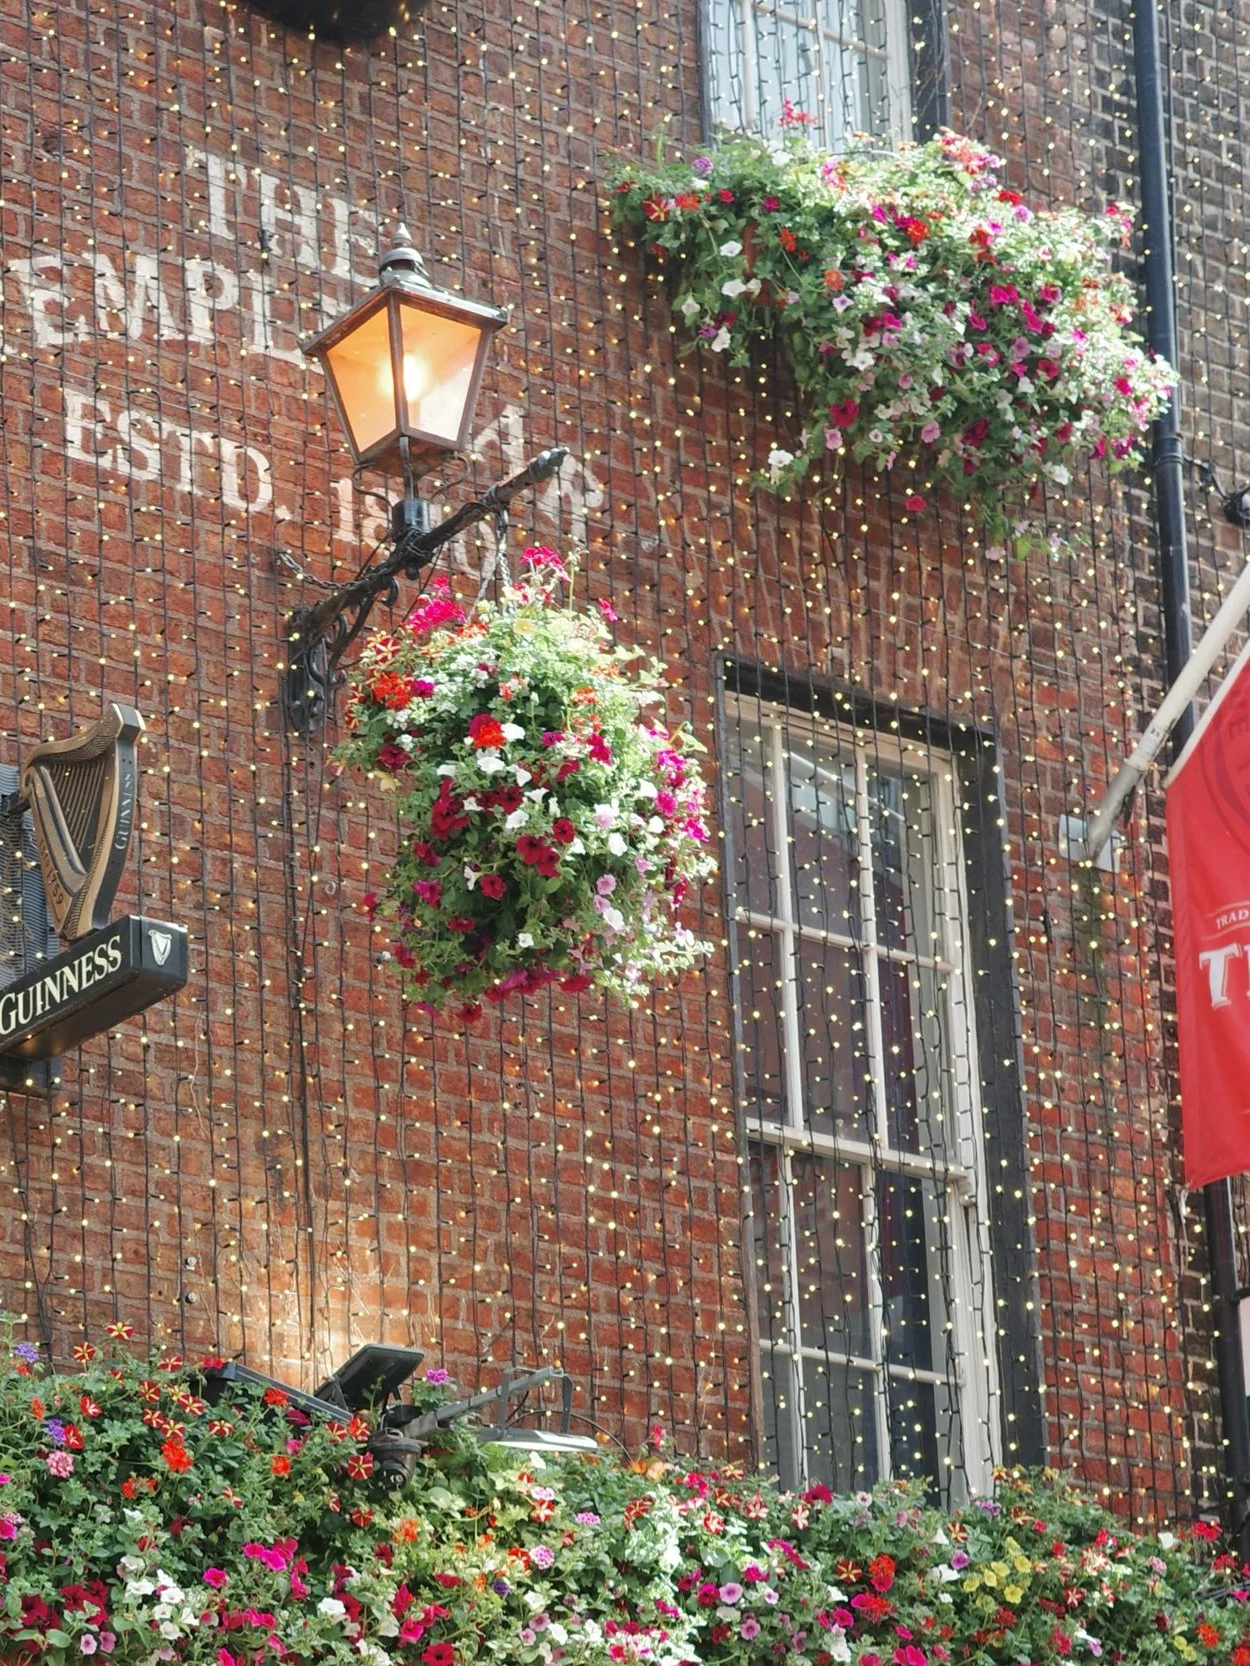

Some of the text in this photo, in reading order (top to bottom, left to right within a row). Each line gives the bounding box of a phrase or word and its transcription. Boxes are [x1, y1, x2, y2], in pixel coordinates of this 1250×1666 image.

[184, 147, 384, 289] THE
[64, 388, 498, 586] ESTD. 180
